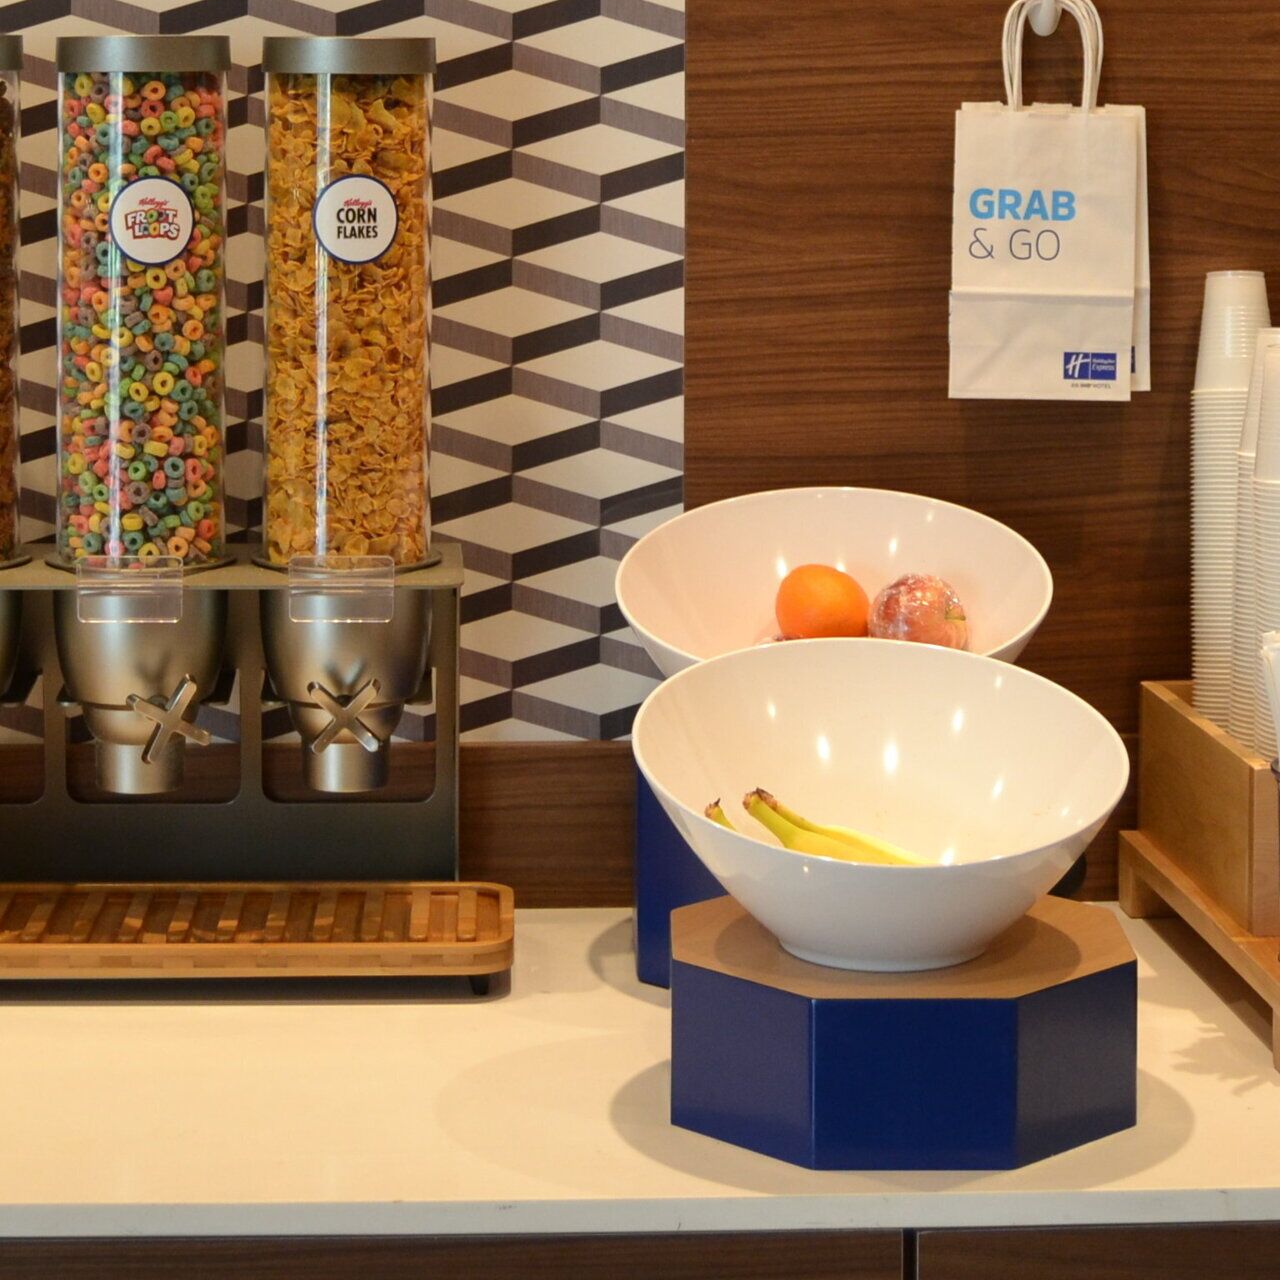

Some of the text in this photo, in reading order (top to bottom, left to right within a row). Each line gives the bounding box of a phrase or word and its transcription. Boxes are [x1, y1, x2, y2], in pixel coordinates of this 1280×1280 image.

[969, 188, 1076, 221] GRAB
[336, 207, 377, 224] CORN
[133, 222, 180, 240] LOOPS
[337, 225, 378, 239] FLAKES
[968, 227, 1061, 261] & GO
